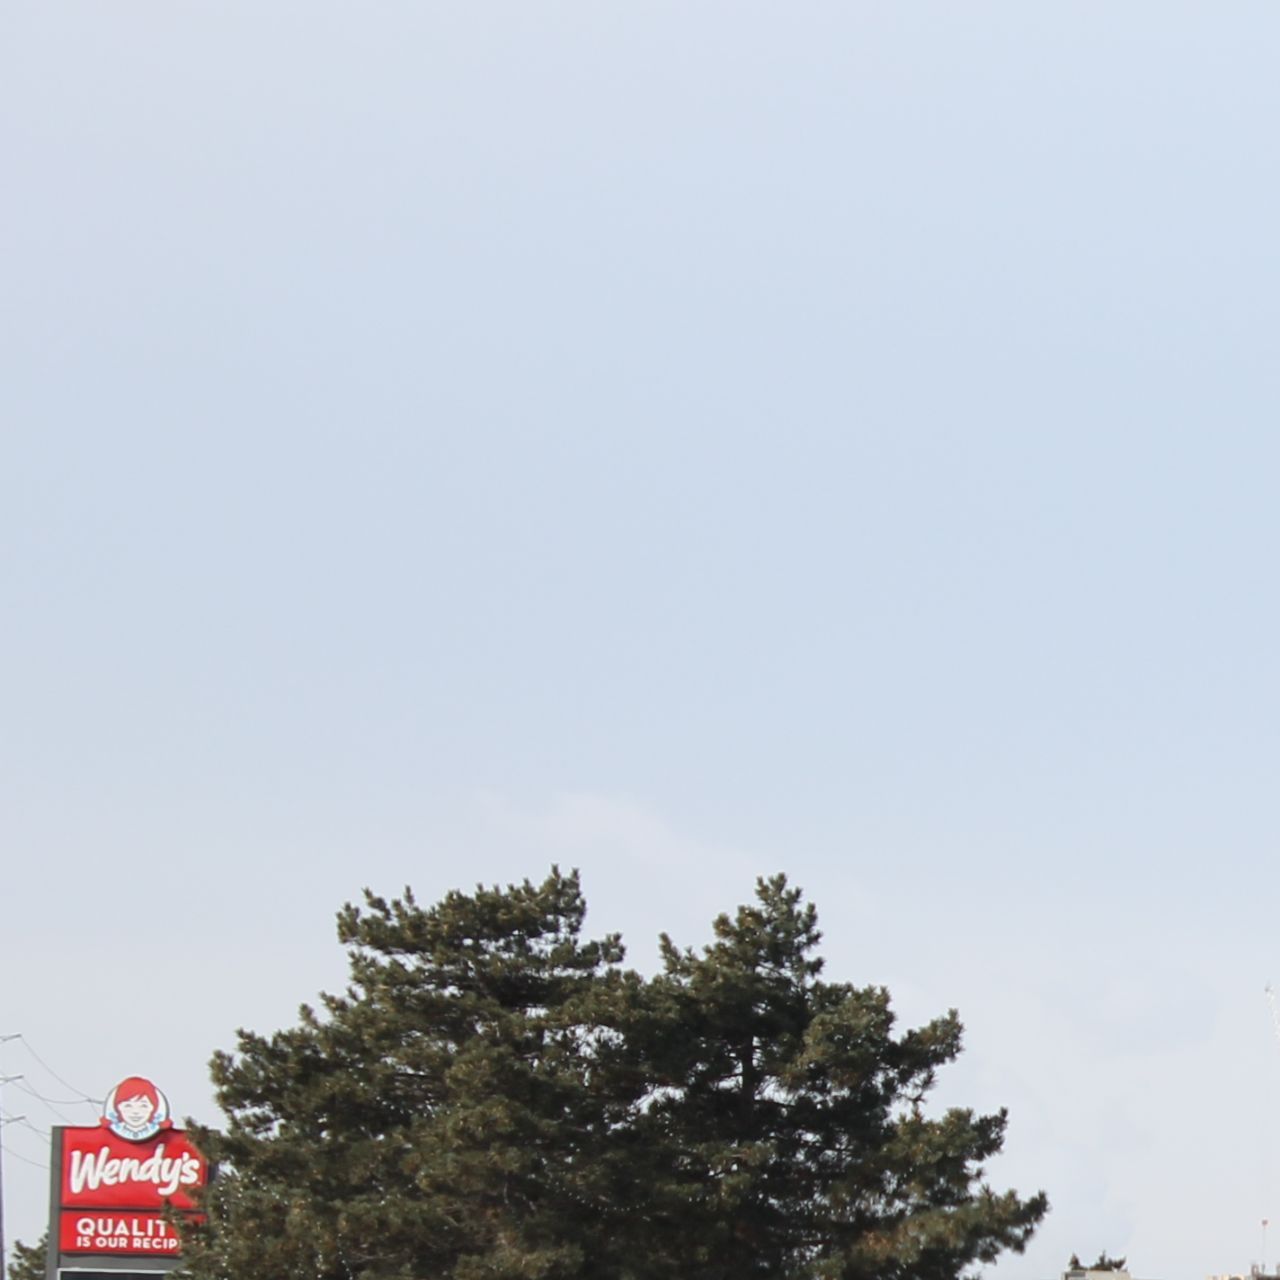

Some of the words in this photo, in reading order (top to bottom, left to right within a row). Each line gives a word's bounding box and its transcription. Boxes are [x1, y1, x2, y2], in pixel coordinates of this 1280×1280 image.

[71, 1144, 200, 1195] Wendy's
[77, 1218, 168, 1236] QUALIT
[77, 1237, 91, 1248] IS
[96, 1237, 128, 1249] OUR
[133, 1237, 182, 1250] RECIP
